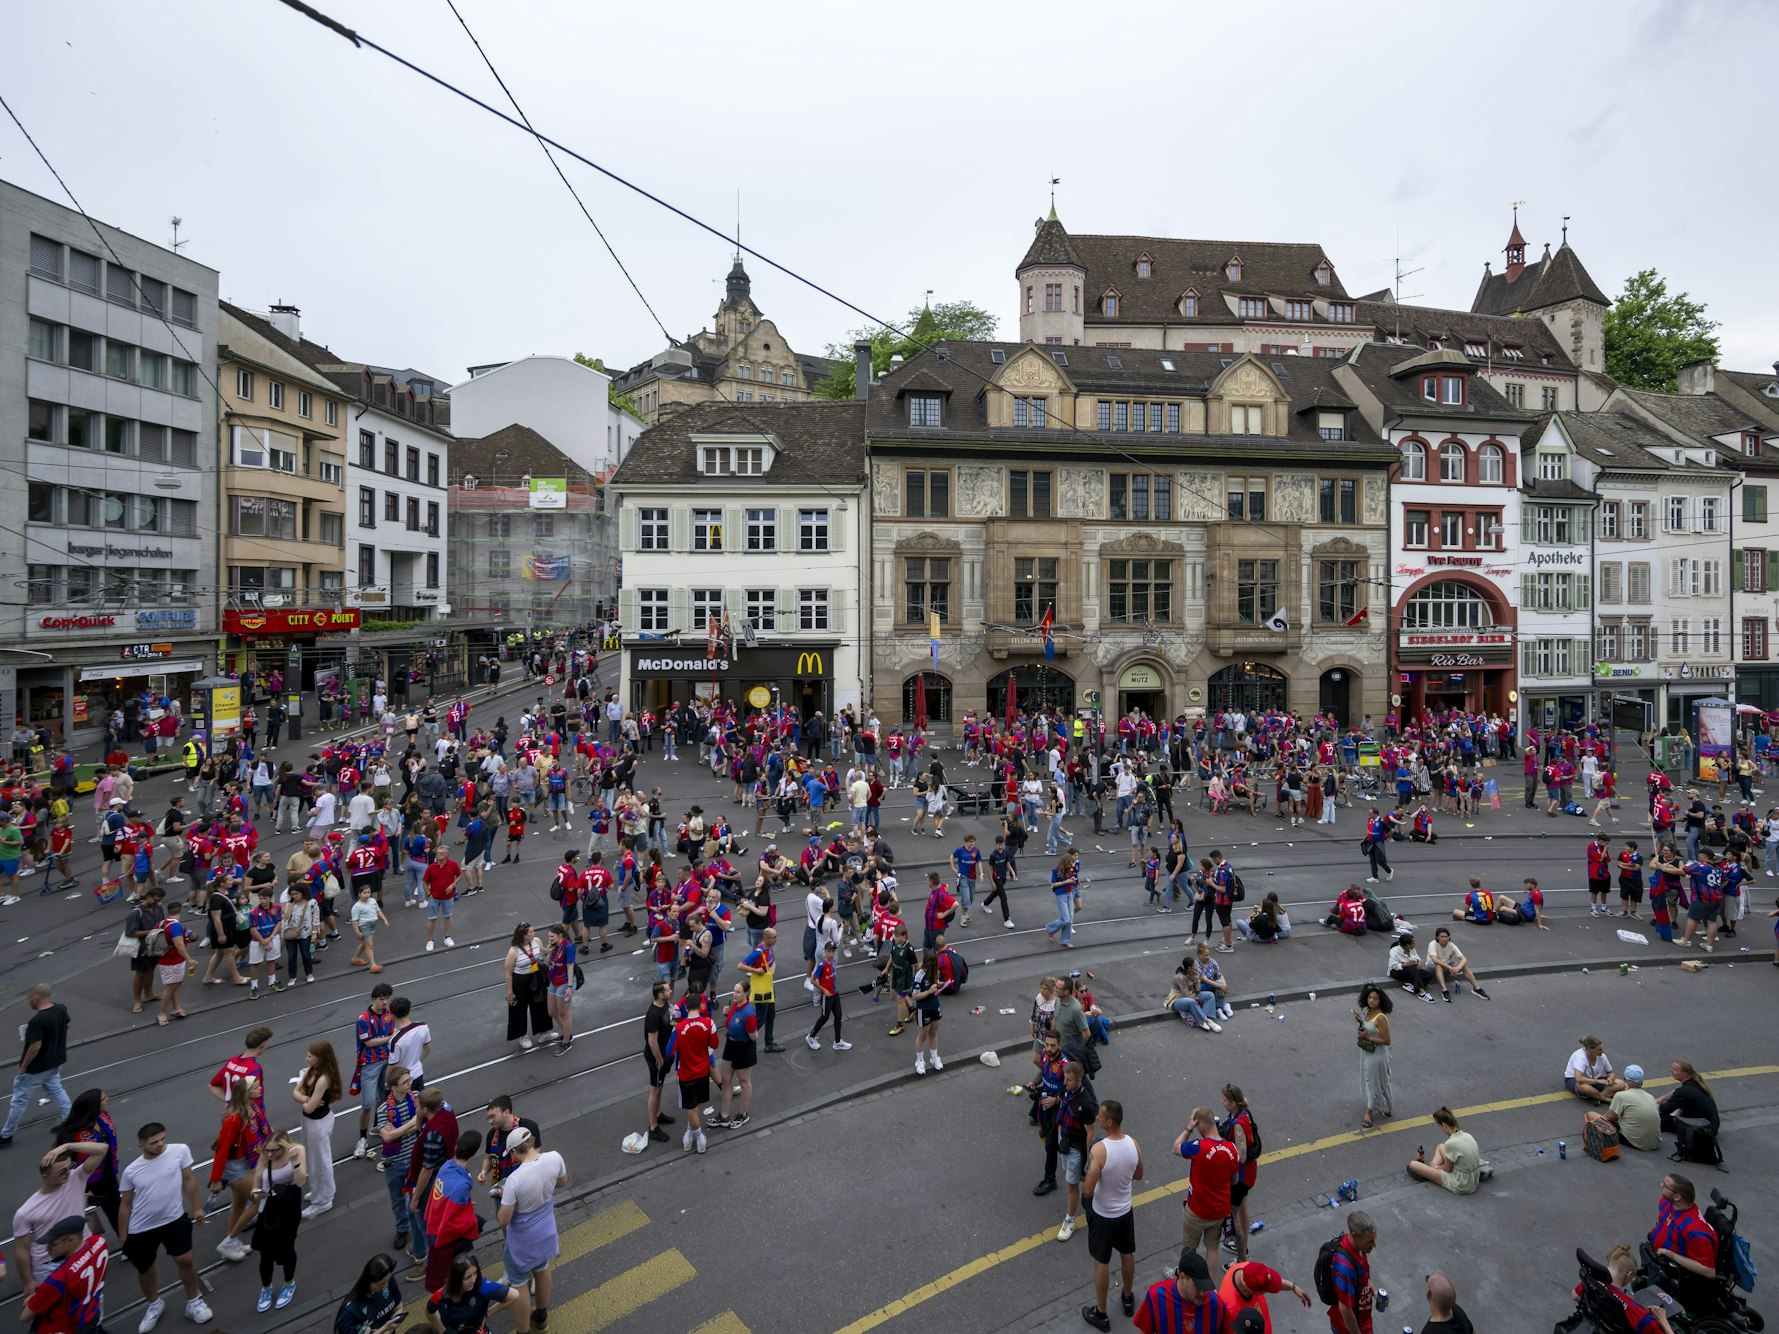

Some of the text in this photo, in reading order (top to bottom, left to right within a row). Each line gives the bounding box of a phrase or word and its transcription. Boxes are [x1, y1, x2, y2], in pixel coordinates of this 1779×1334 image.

[1528, 551, 1583, 567] Apotheke
[40, 615, 116, 629] CopyQuick
[288, 614, 309, 625] CITY
[331, 613, 355, 624] POINT
[1408, 635, 1506, 645] ZIEGELHOF BIER
[291, 644, 298, 652] A
[637, 658, 729, 671] McDonald's
[1431, 654, 1486, 666] Rio Bar
[1612, 669, 1633, 677] BENU
[1690, 666, 1721, 678] SPARKS
[340, 770, 351, 783] 12
[356, 852, 376, 868] 12
[1478, 895, 1492, 911] 34
[1350, 905, 1365, 922] 12
[80, 1249, 108, 1304] 12
